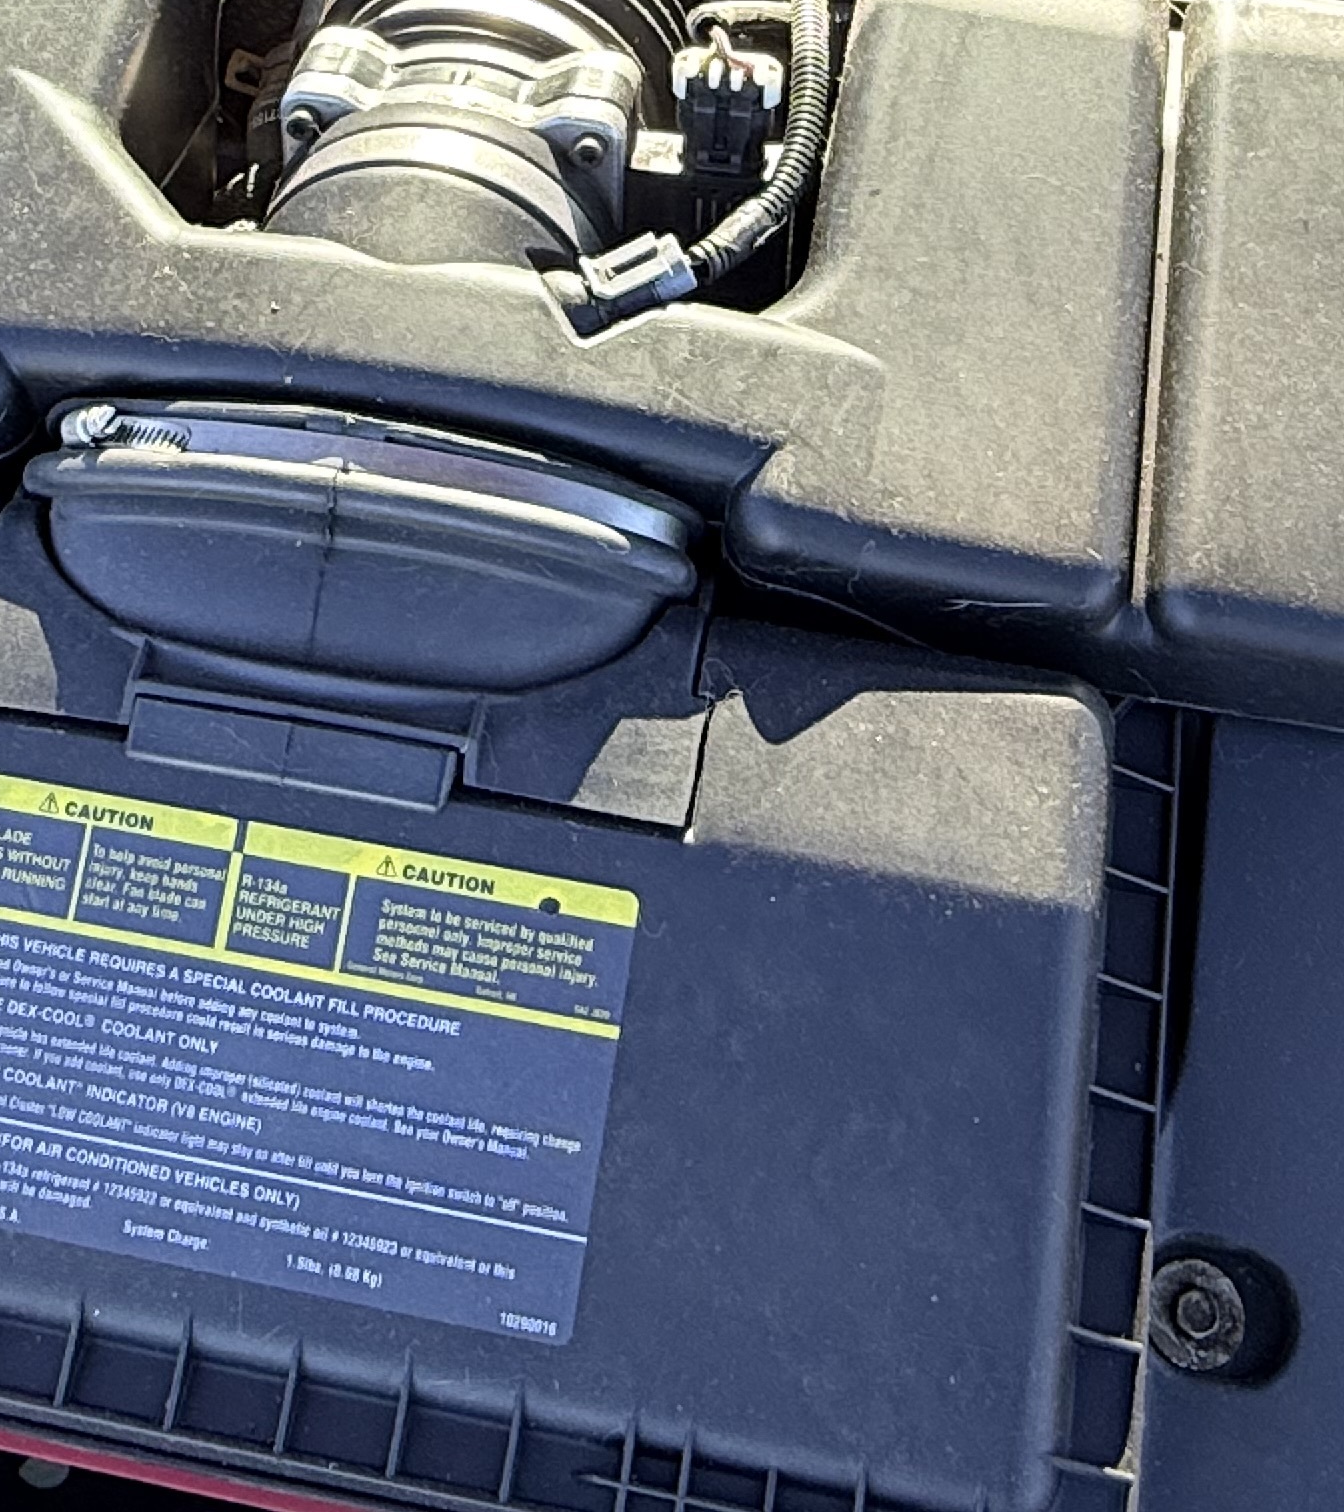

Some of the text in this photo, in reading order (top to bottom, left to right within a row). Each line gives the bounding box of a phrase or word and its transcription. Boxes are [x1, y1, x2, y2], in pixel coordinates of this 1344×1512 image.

[63, 801, 155, 831] CAUTION
[6, 848, 71, 873] WITHOUT
[0, 865, 67, 892] RUNNING
[401, 863, 496, 895] CAUTION
[235, 906, 325, 935] UNDER HIGH
[238, 890, 341, 922] REFRIGERANT
[380, 898, 427, 921] System
[232, 922, 310, 949] PRESSURE
[372, 947, 397, 965] See
[399, 952, 447, 974] Service
[22, 937, 86, 964] VEHICLE
[88, 949, 167, 979] REQUIRES
[168, 965, 180, 982] A
[182, 967, 248, 994] SPECIAL
[249, 980, 325, 1009] COOLANT
[326, 995, 361, 1016] FILL
[362, 1001, 461, 1035] PROCEDURE
[100, 1017, 176, 1047] COOLANT
[177, 1031, 219, 1055] ONLY
[85, 1082, 169, 1115] INDICATOR
[197, 1104, 263, 1134] ENGINE)
[34, 1139, 63, 1161] AIR
[63, 1145, 171, 1183] CONDITIONED
[172, 1167, 251, 1200] VEHICLES
[252, 1184, 301, 1210] ONLY)
